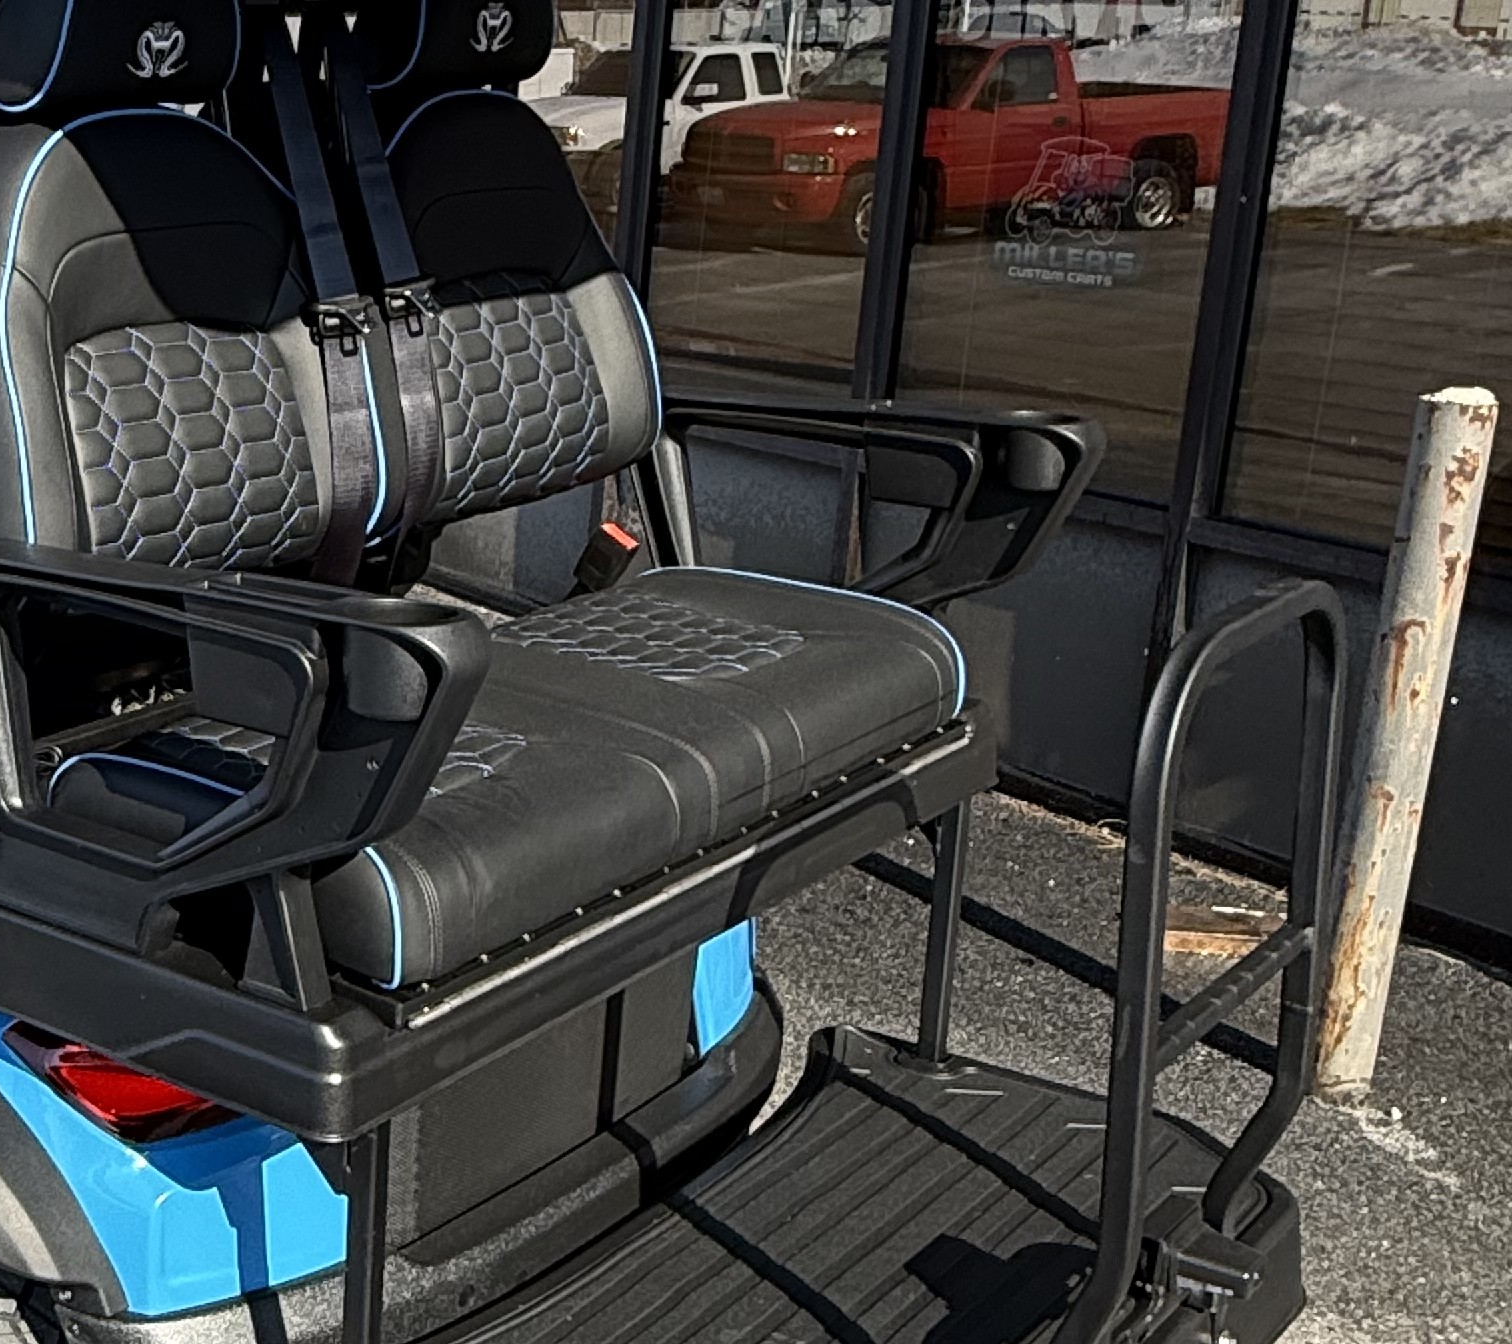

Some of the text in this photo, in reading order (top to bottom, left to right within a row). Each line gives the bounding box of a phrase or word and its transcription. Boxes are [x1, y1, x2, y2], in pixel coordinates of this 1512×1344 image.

[994, 241, 1136, 274] MILLER'S
[1008, 267, 1113, 287] CUSTOM CARTS
